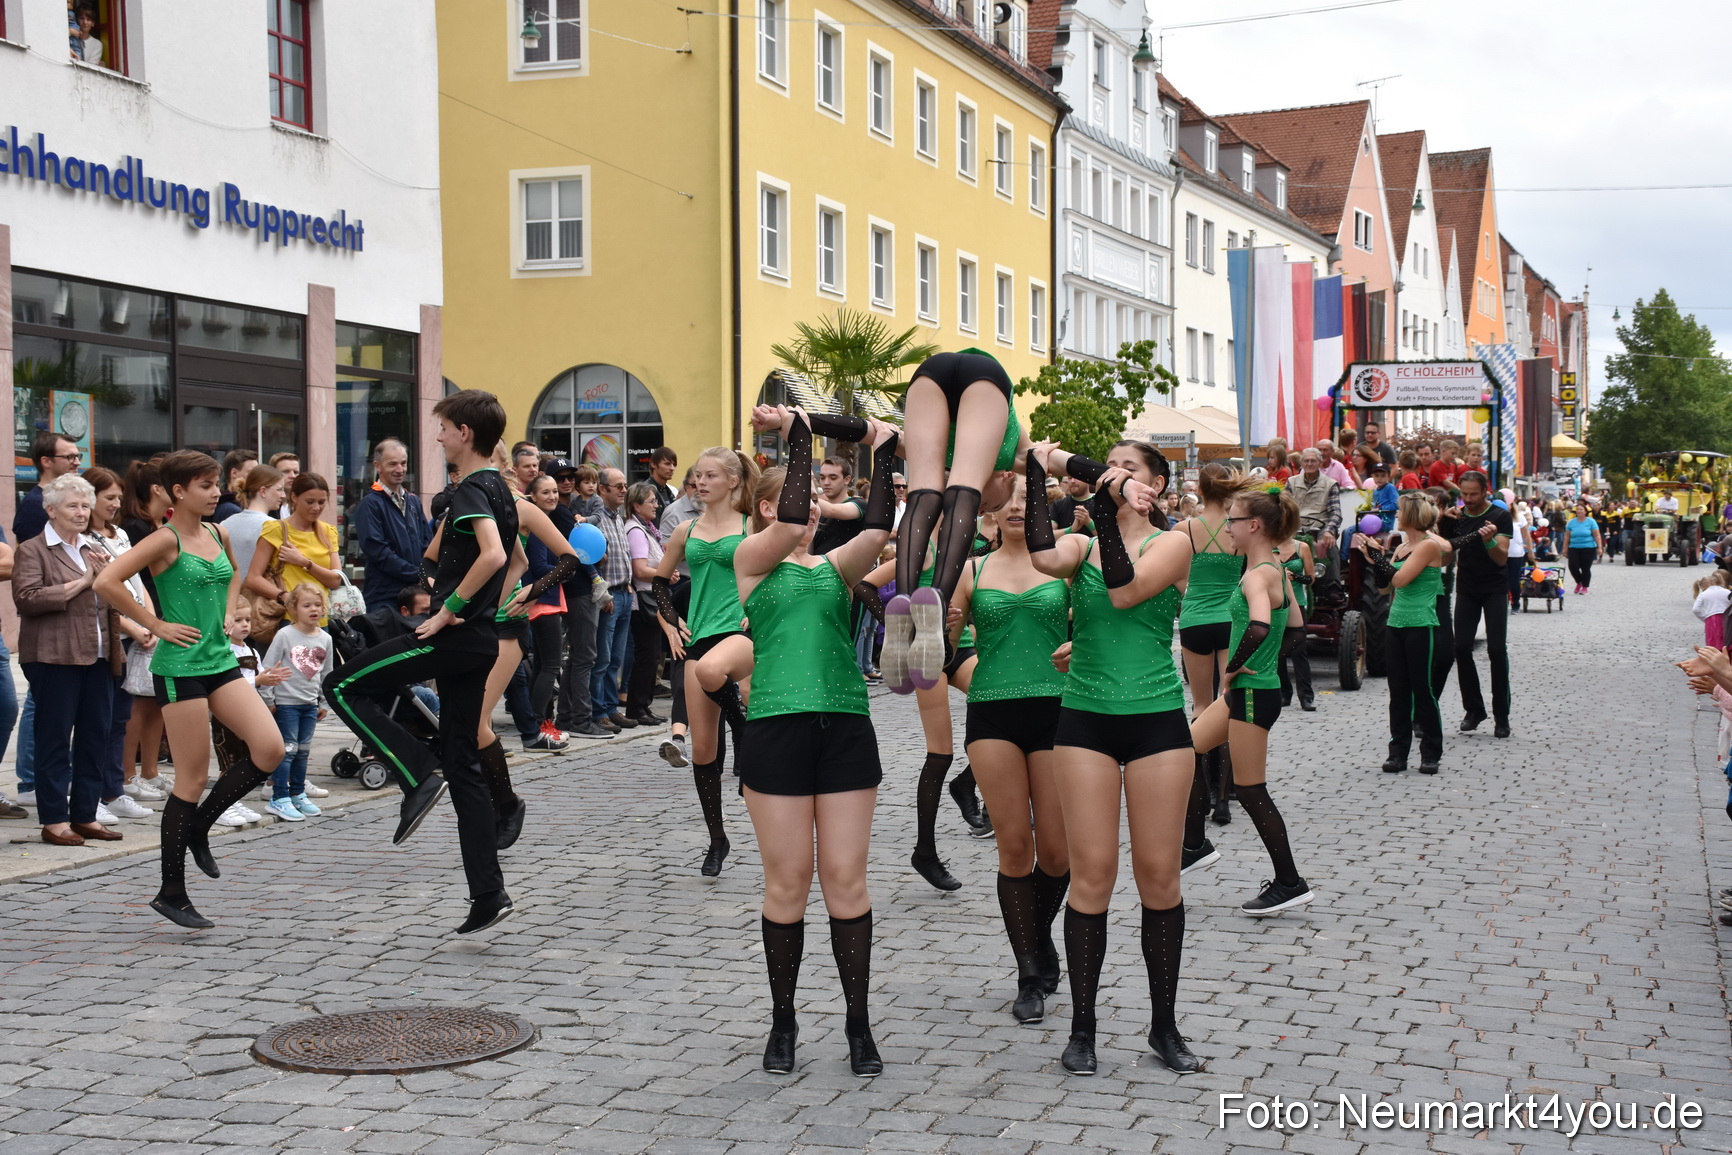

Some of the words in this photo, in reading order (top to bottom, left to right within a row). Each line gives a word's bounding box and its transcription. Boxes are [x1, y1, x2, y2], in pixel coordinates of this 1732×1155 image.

[220, 181, 364, 252] Rupprecht
[1396, 367, 1410, 377] FC
[1413, 366, 1474, 377] HOLZHEIM
[585, 383, 608, 400] FOTO
[1444, 385, 1478, 393] Gymnastik,
[577, 398, 620, 410] hailer
[1561, 373, 1576, 432] HOTE
[337, 405, 396, 415] Empfehlungen
[1151, 434, 1186, 442] Klostergasse
